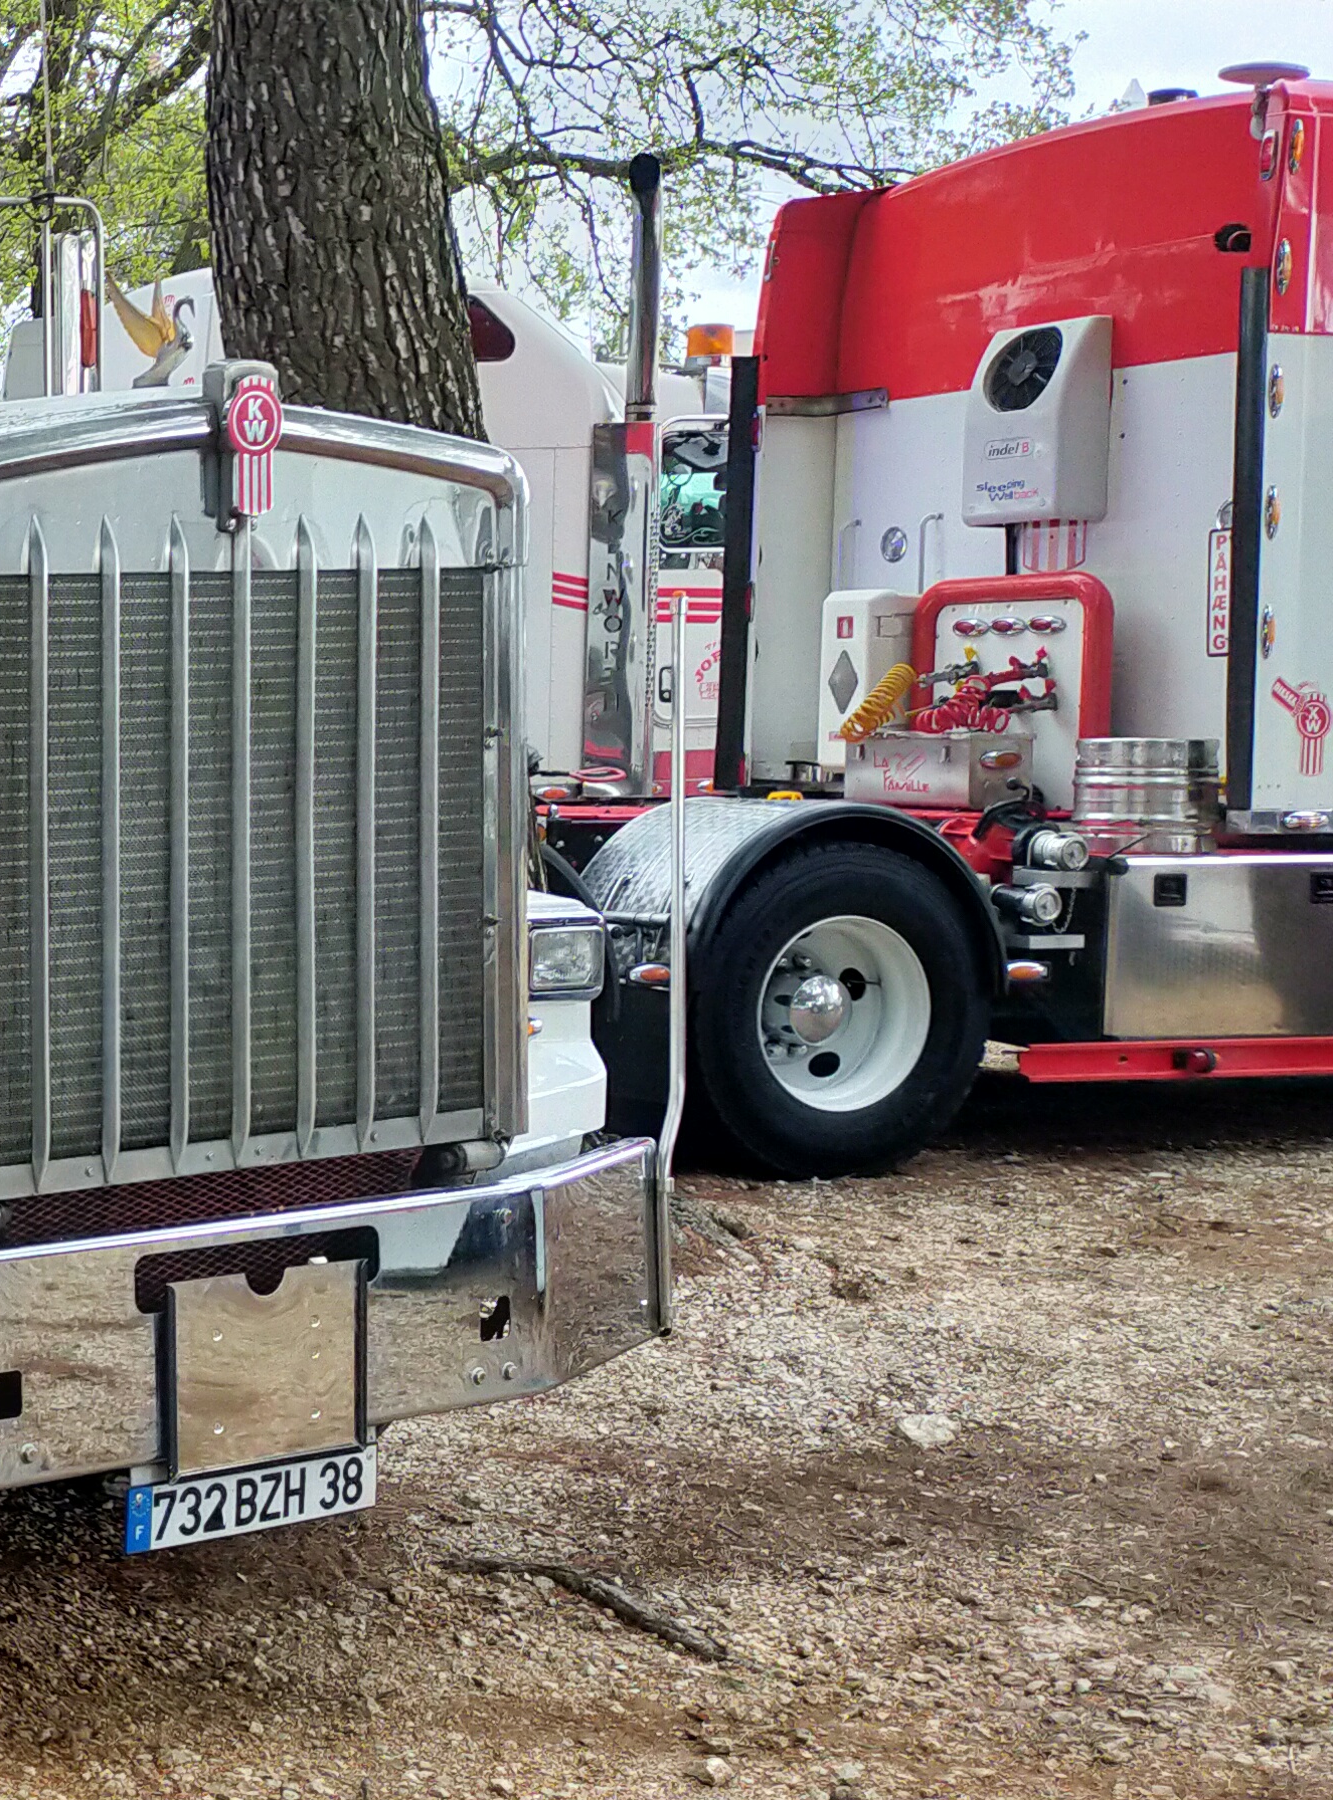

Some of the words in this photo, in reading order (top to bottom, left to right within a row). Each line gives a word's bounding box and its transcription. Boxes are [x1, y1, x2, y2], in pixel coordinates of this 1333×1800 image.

[988, 442, 1019, 457] indel
[1022, 441, 1030, 453] B
[1212, 534, 1227, 650] PÅHÆNG
[153, 1482, 227, 1542] 732
[234, 1467, 306, 1527] BZH
[319, 1457, 363, 1510] 38
[135, 1525, 145, 1541] F
